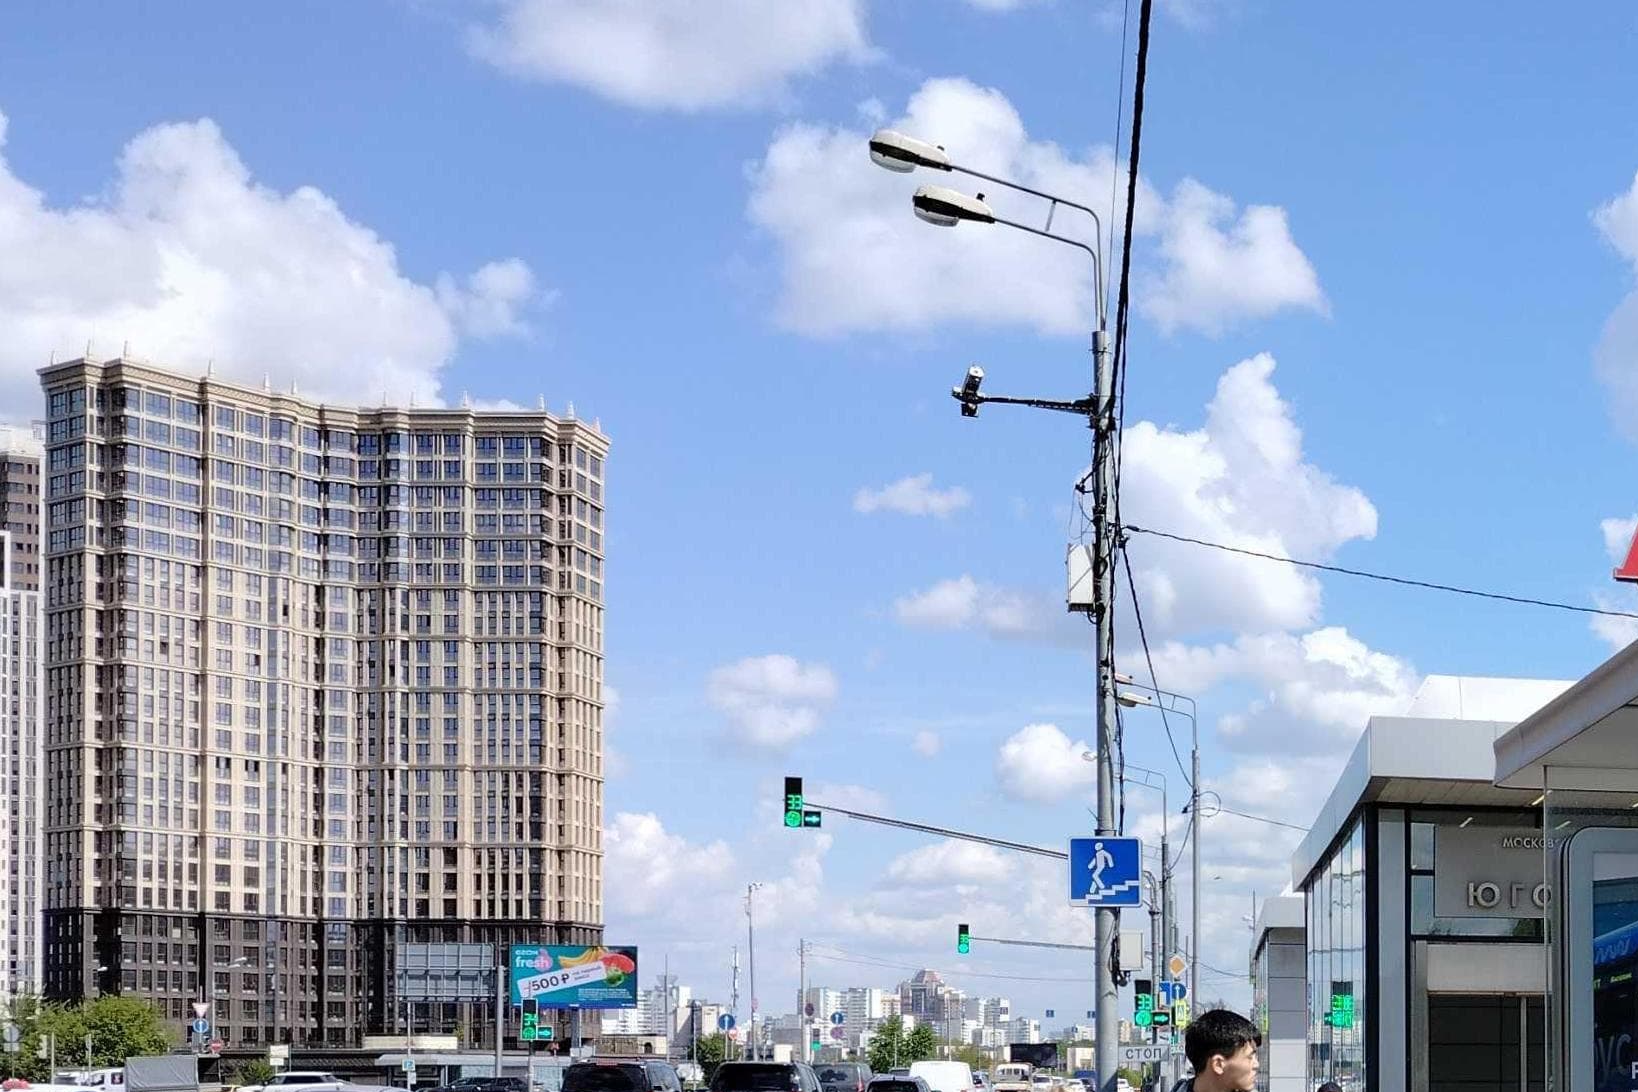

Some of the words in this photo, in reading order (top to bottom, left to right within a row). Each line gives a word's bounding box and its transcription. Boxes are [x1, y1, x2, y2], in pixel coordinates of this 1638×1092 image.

[1503, 837, 1560, 849] МОСКОВ
[1468, 882, 1553, 908] ЮГО
[1126, 1048, 1162, 1060] СТОП
